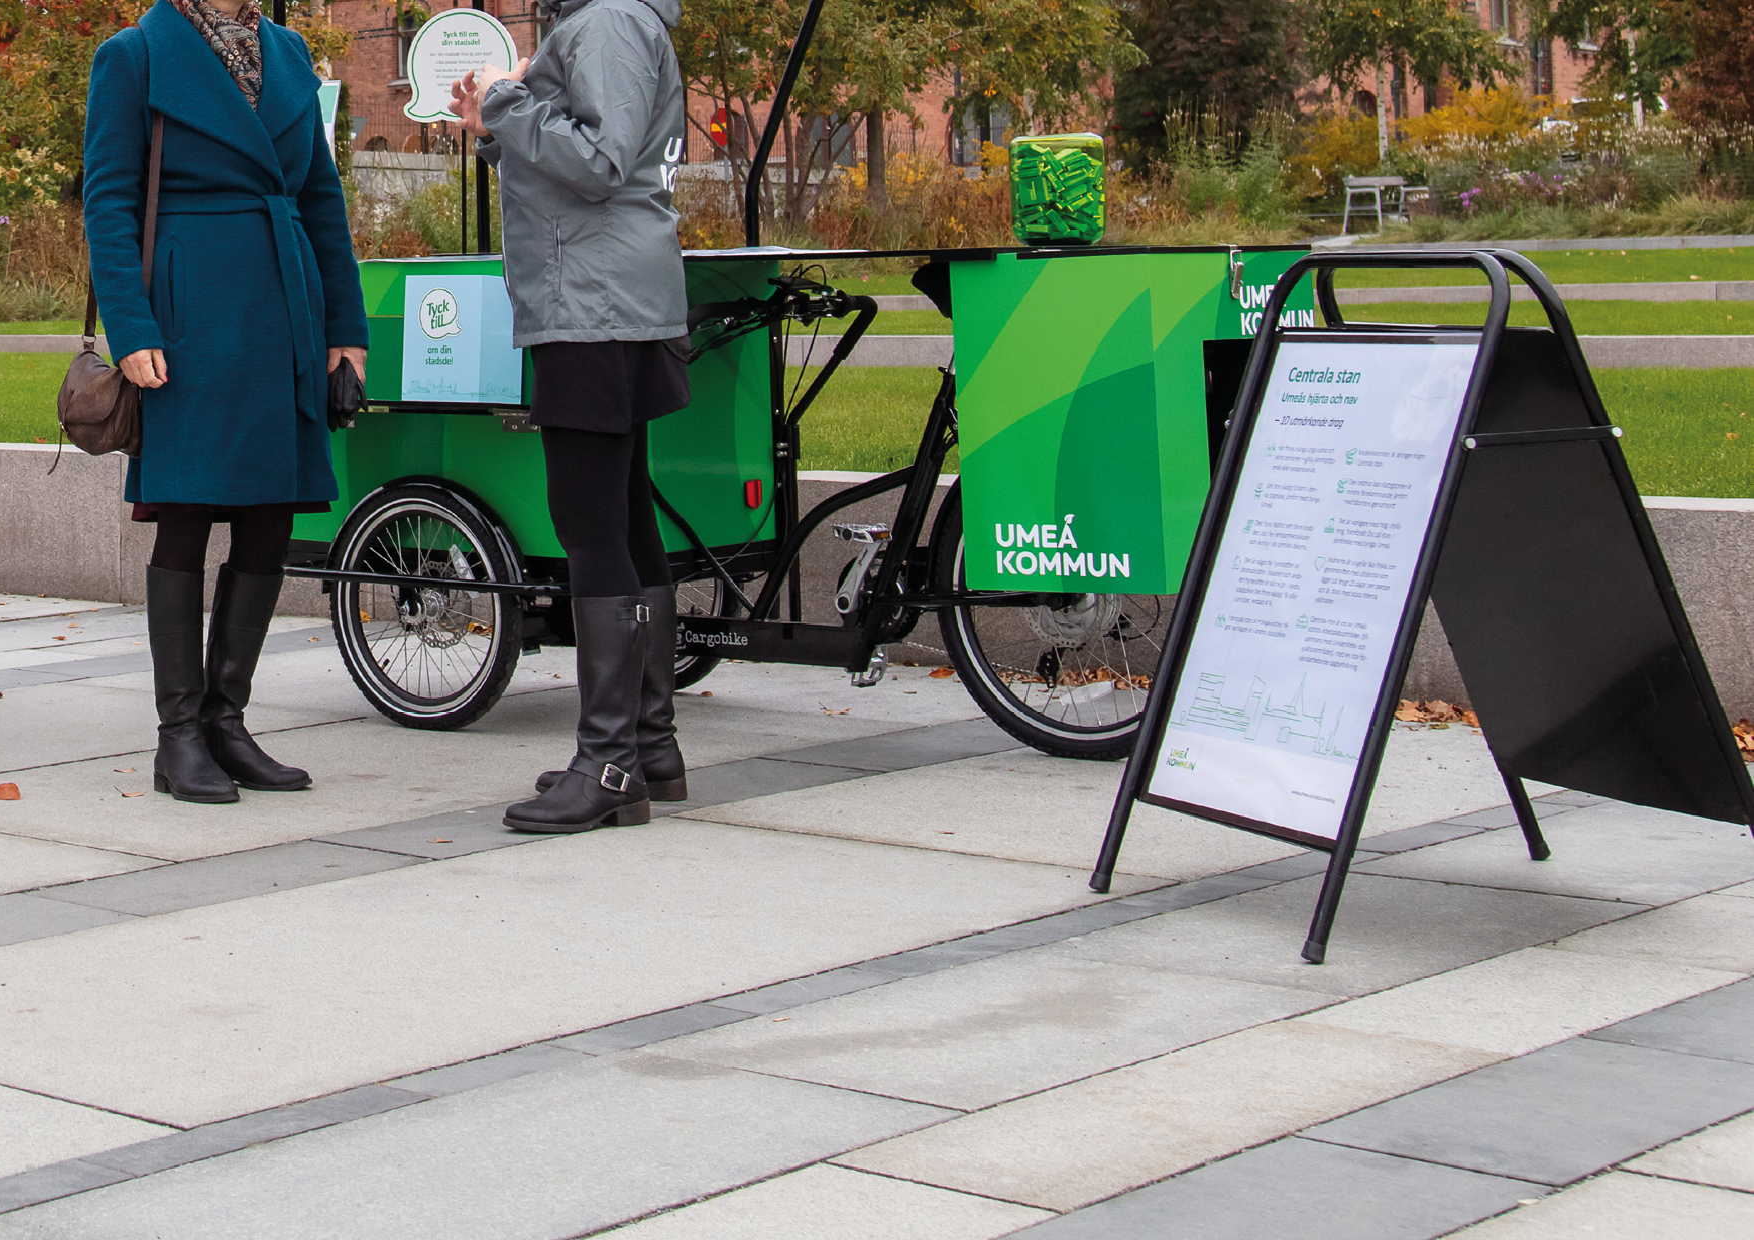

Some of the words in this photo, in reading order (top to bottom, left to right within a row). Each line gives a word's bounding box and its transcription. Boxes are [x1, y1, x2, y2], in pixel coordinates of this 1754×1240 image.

[443, 31, 458, 39] Tyck
[426, 299, 450, 317] Tyck
[430, 315, 446, 330] till
[427, 346, 439, 354] om
[440, 345, 452, 354] din
[425, 357, 453, 365] stadsdel
[1288, 367, 1334, 383] Centrala
[1336, 369, 1361, 383] stan
[1282, 392, 1306, 404] Umeås
[1307, 393, 1329, 405] hjärta
[1330, 394, 1343, 404] och
[1344, 396, 1359, 404] nav
[1280, 416, 1290, 426] 10
[1290, 416, 1327, 427] utmärkande
[1328, 417, 1344, 429] drag
[995, 514, 1078, 549] UMEÅ
[996, 550, 1130, 578] KOMMUN
[685, 630, 748, 647] Cargobike
[1170, 748, 1190, 759] UMEÅ
[1166, 757, 1196, 771] KOMMUN
